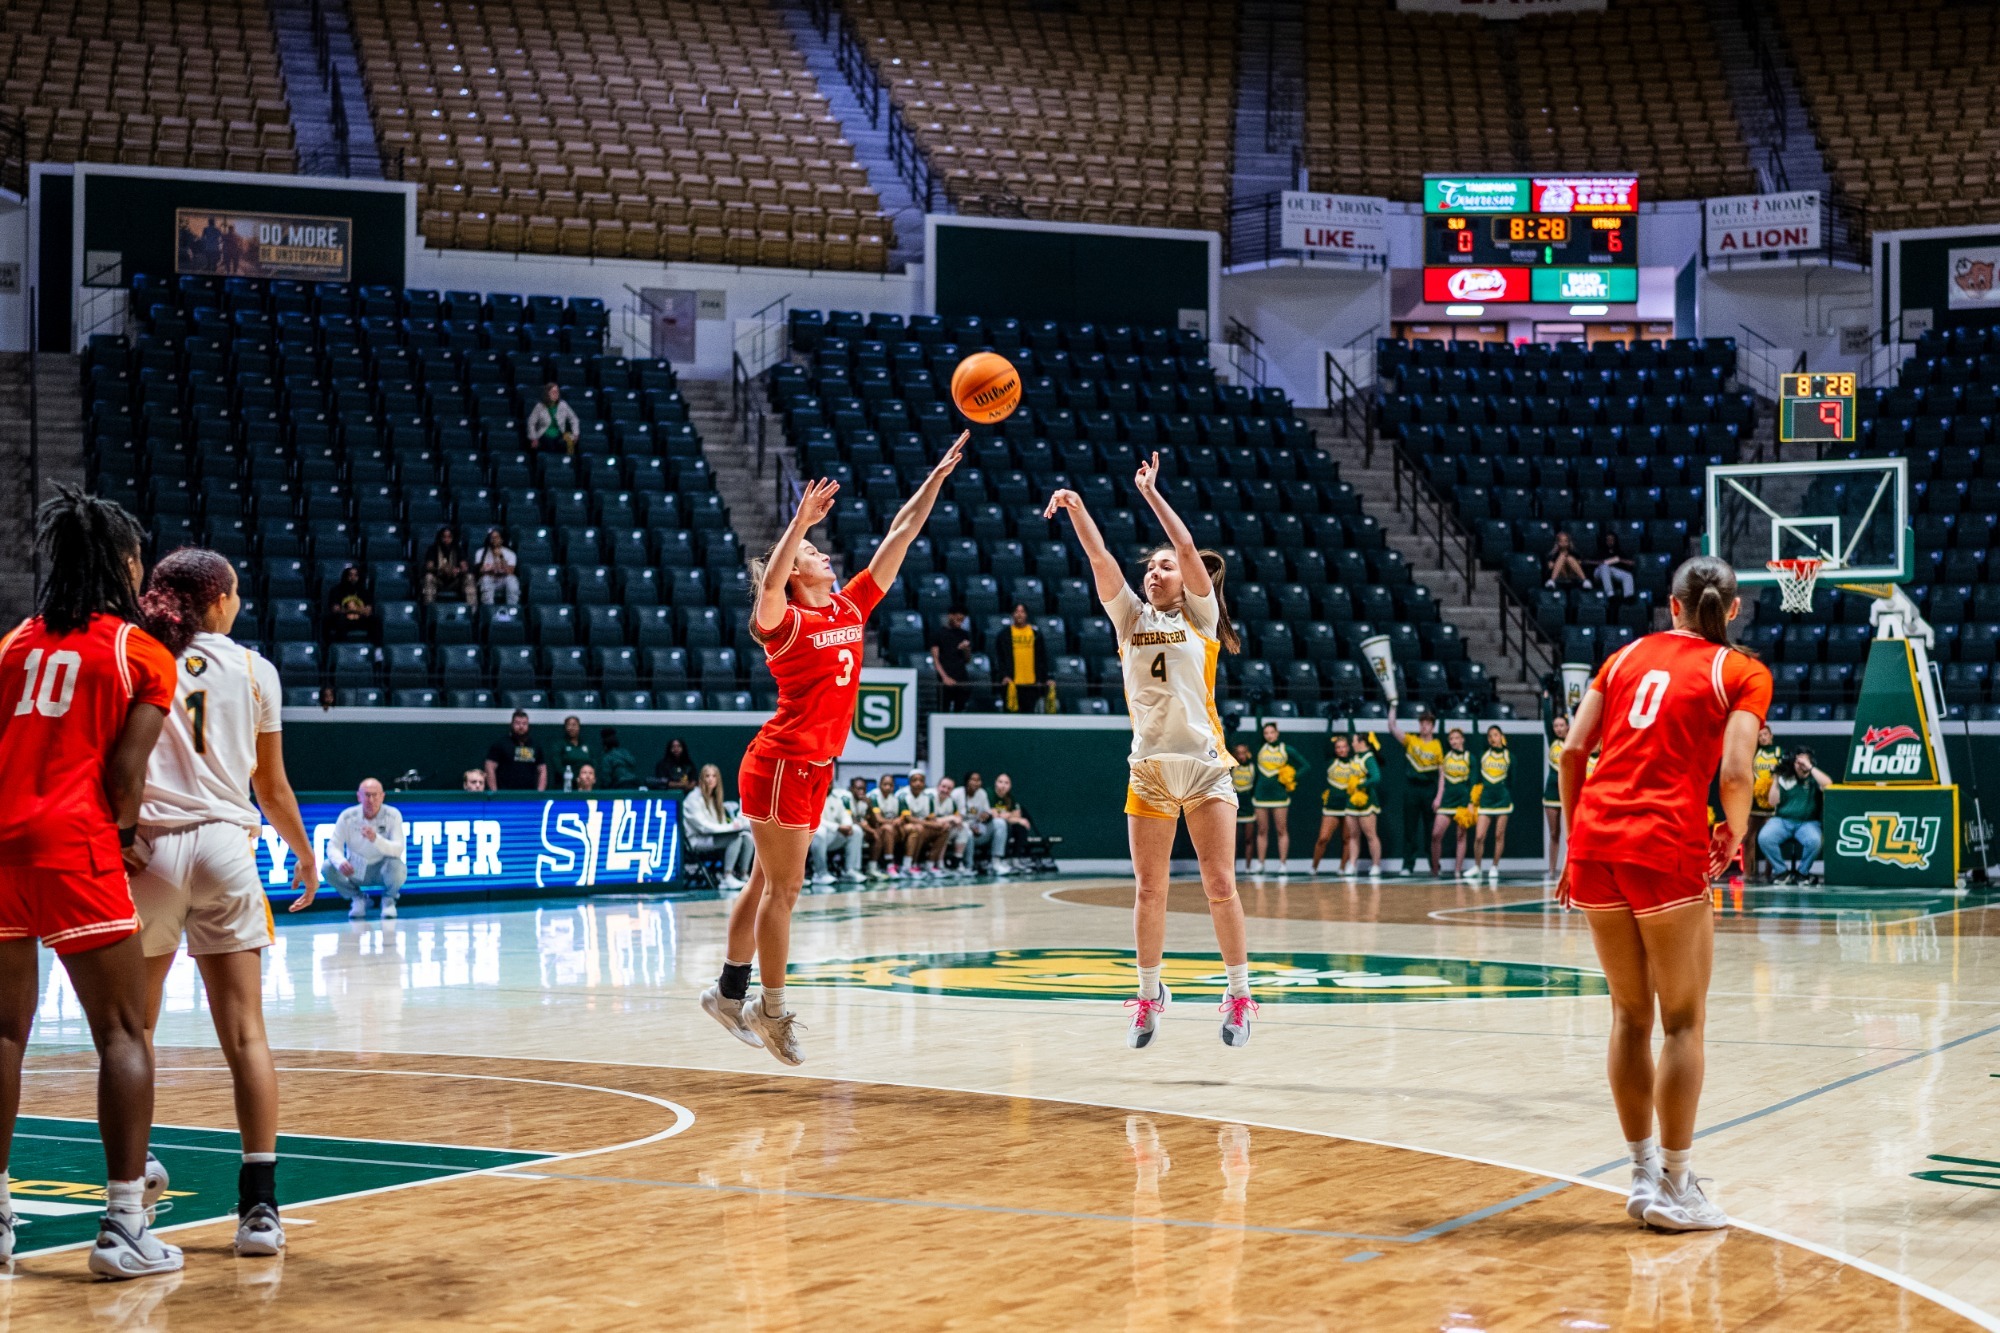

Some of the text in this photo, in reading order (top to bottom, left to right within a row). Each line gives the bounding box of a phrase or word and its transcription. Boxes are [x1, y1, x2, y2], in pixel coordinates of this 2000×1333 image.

[1286, 197, 1321, 211] OUR
[1438, 180, 1516, 207] Tourism
[1712, 201, 1748, 215] OUR
[259, 223, 282, 246] DO
[1304, 228, 1375, 250] LIKE...
[1510, 217, 1565, 240] 8:28
[1720, 227, 1808, 250] A LION!
[1458, 230, 1473, 253] 0
[1568, 272, 1602, 284] BUD
[1561, 283, 1608, 297] LIGHT
[973, 378, 1016, 407] Wilson
[1797, 374, 1853, 397] 8:28
[1819, 402, 1842, 439] 9
[1131, 629, 1187, 647] OUTHEASTERN
[835, 649, 854, 687] 3
[1150, 651, 1167, 683] 4
[14, 648, 82, 717] 10
[1628, 669, 1671, 729] 0
[184, 690, 208, 755] 1
[863, 694, 891, 729] S
[1896, 743, 1922, 756] Bill
[1836, 812, 1941, 864] SLU
